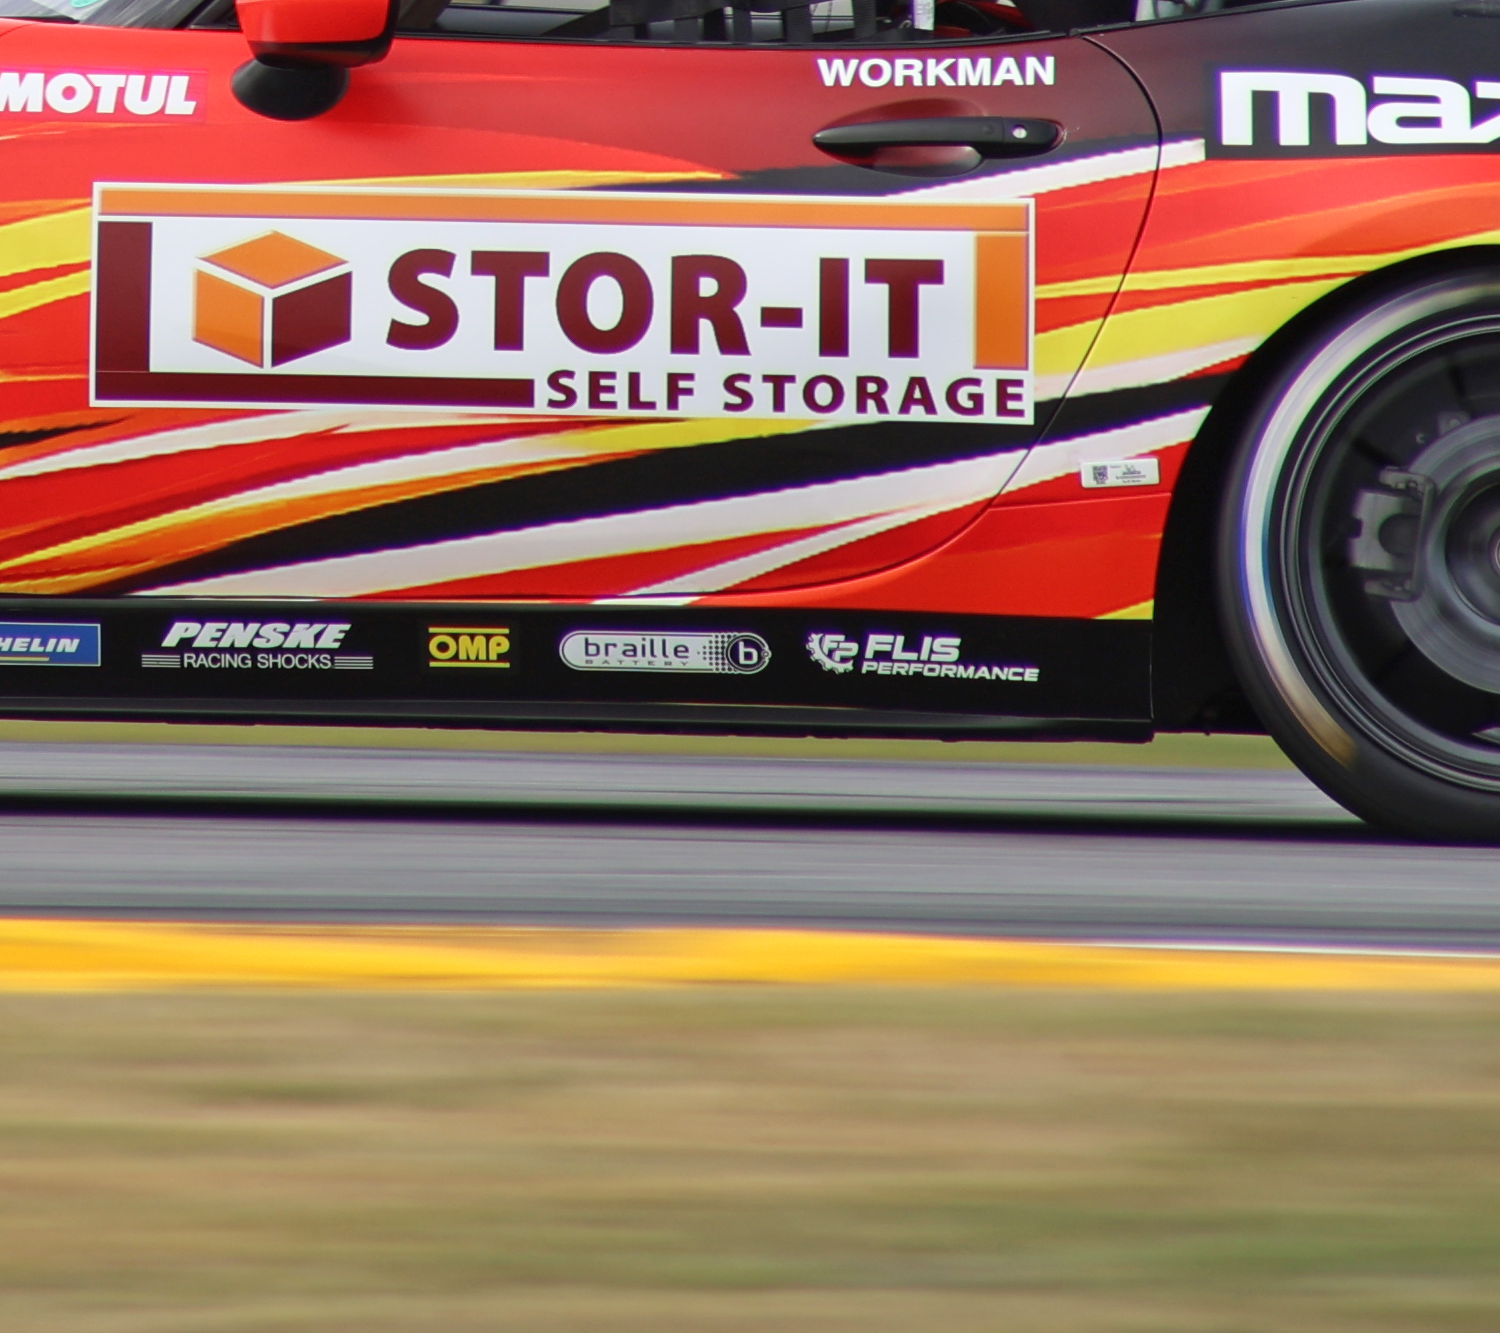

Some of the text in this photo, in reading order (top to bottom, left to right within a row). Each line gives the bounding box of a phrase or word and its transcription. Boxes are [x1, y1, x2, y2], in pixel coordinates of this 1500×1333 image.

[817, 56, 1055, 86] WORKMAN
[386, 248, 945, 358] STOR-IT
[546, 370, 1026, 418] SELF STORAGE
[160, 622, 352, 649] PENSKE
[429, 634, 510, 661] OMP
[584, 637, 690, 659] braille
[864, 634, 962, 662] FLIS
[183, 654, 332, 669] RACING SHOCKS
[861, 661, 1040, 682] PERFORMANCE
